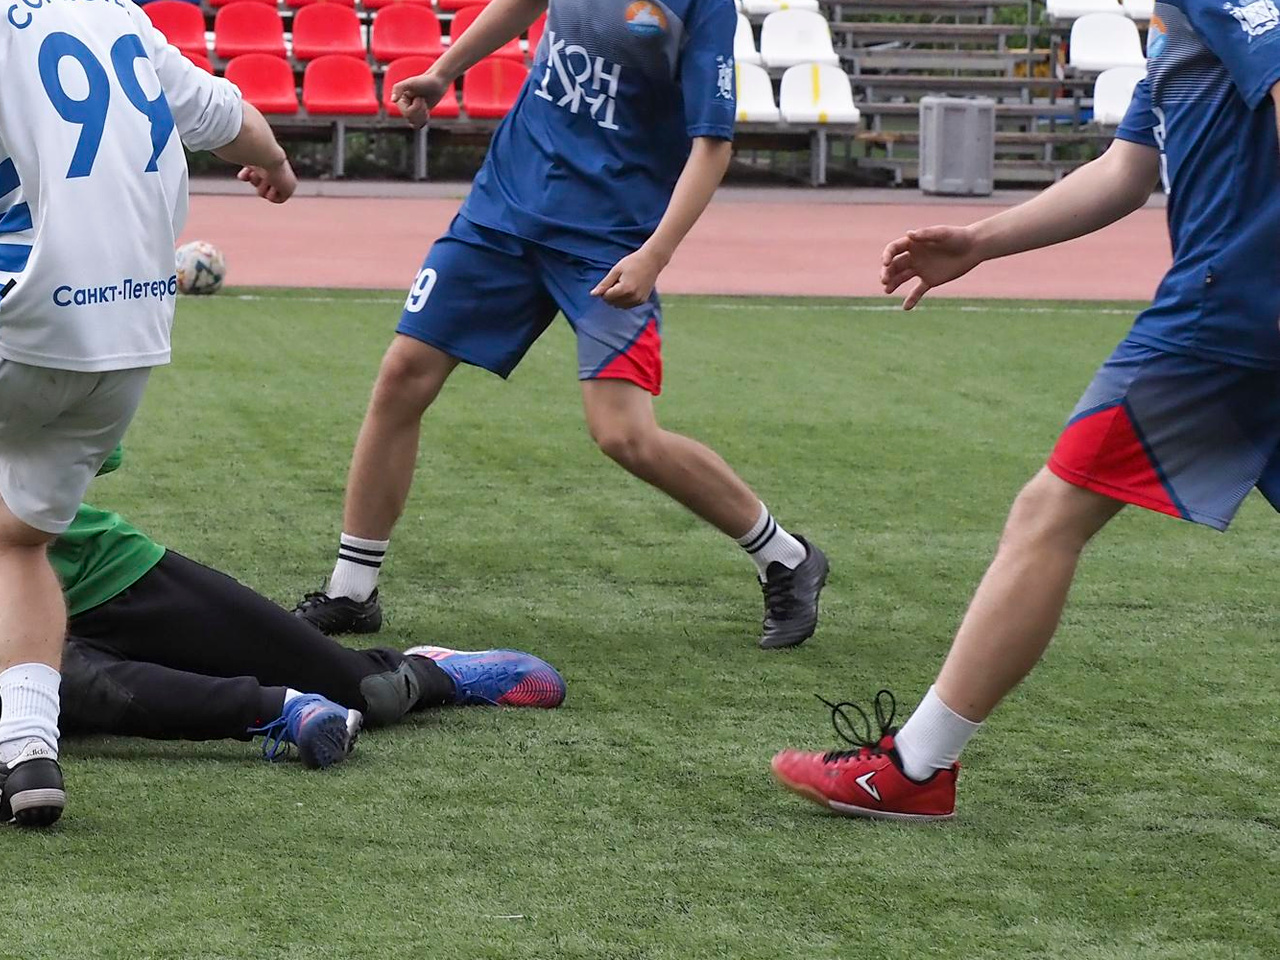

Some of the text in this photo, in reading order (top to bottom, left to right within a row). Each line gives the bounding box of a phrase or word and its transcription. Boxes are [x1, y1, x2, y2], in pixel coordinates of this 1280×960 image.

[547, 31, 621, 100] КОН
[37, 31, 175, 179] 99
[52, 275, 176, 307] Санкт-Петерб
